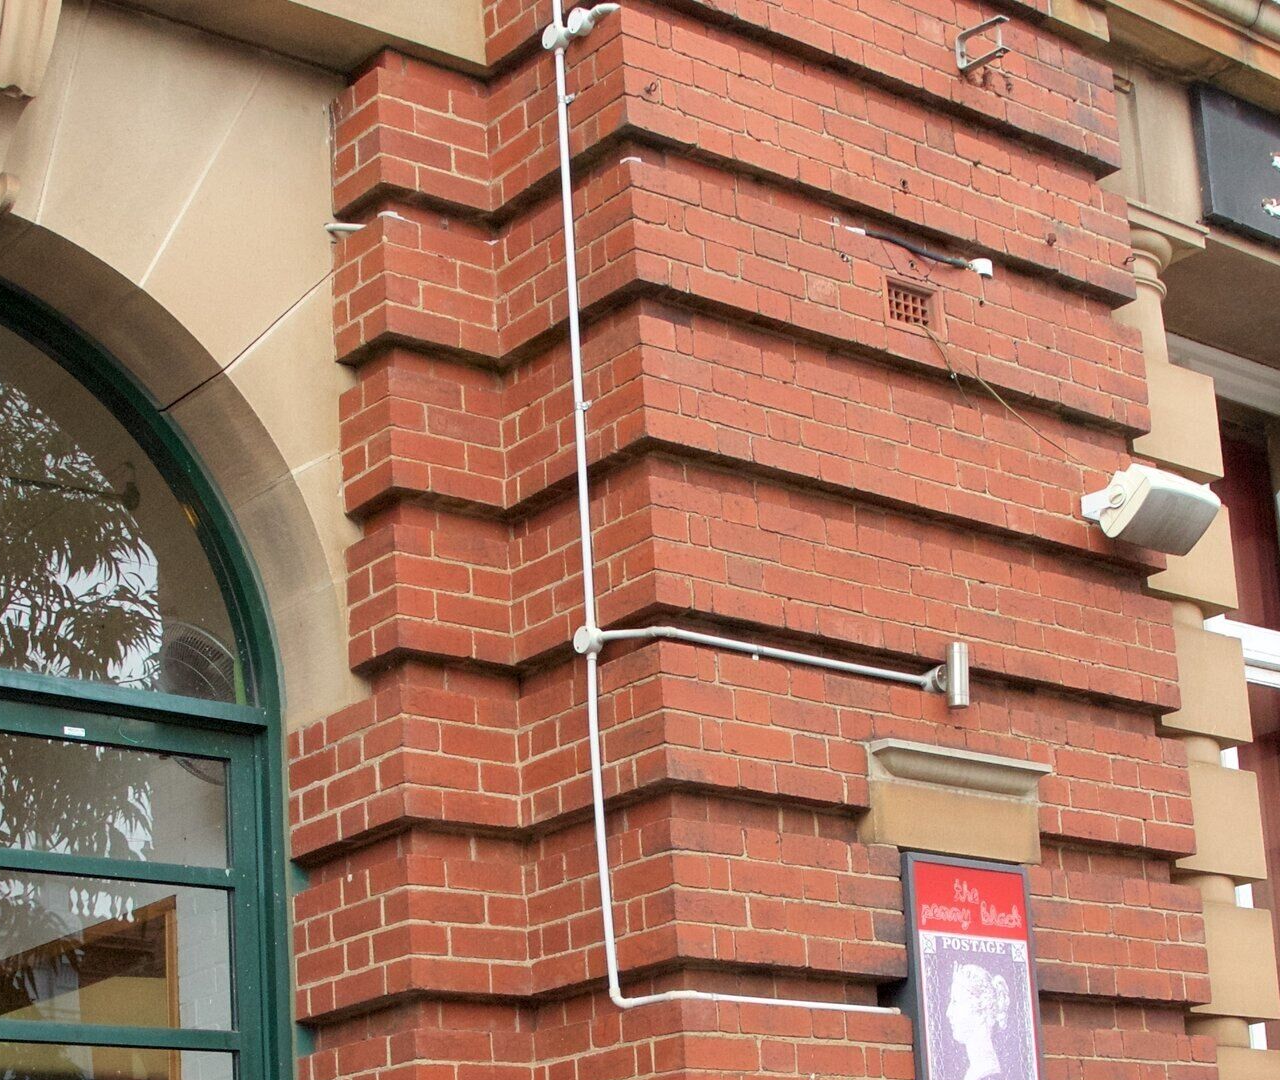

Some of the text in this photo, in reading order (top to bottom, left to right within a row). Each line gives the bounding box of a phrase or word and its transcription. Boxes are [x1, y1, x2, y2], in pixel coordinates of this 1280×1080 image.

[953, 878, 979, 904] the
[921, 901, 1022, 931] penny black
[941, 937, 1006, 954] POSTAGE
